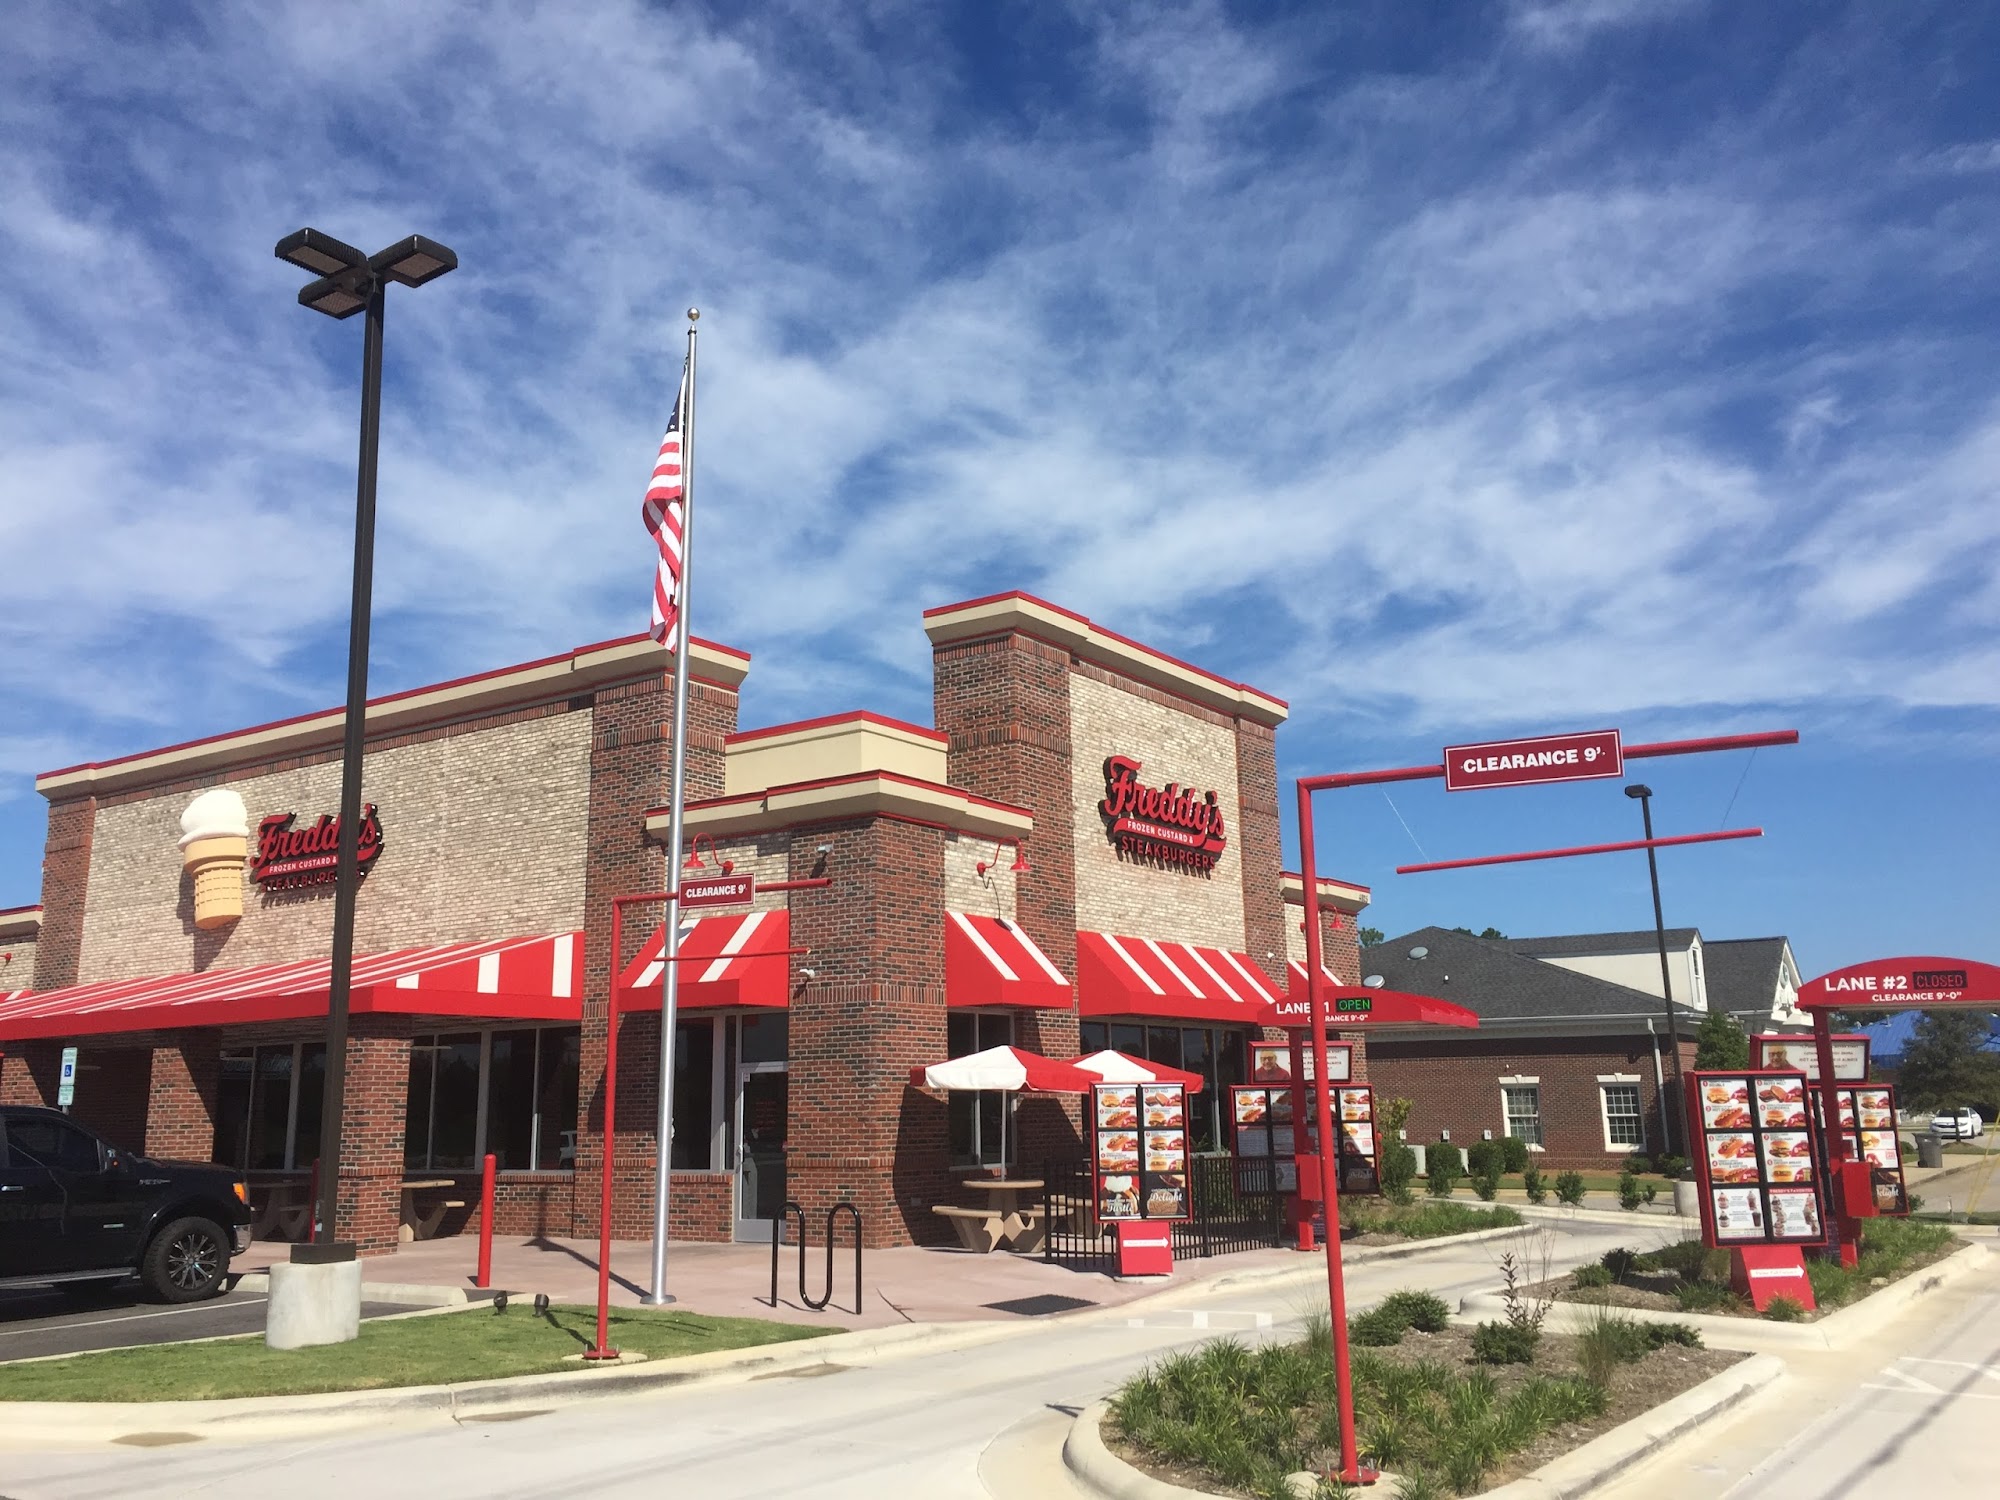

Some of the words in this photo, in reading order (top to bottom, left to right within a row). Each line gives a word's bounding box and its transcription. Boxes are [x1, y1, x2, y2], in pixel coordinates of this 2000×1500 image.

[1463, 749, 1579, 774] CLEARANCE
[1104, 754, 1225, 837] Freddy's
[249, 802, 378, 869] Fredd's
[1127, 820, 1156, 835] FROZEN
[1157, 828, 1188, 842] CUSTARD
[1121, 836, 1216, 870] STEAKBURGERS
[269, 863, 297, 874] FROZEN
[298, 857, 331, 869] CUSTARD
[686, 885, 736, 898] CLEARANCE
[1824, 976, 1878, 991] LANE
[1882, 975, 1908, 990] #2
[1916, 973, 1964, 988] CLOSED
[1339, 998, 1371, 1011] OPEN
[1871, 992, 1935, 1002] CLEARANCE
[1276, 1001, 1311, 1014] LANE
